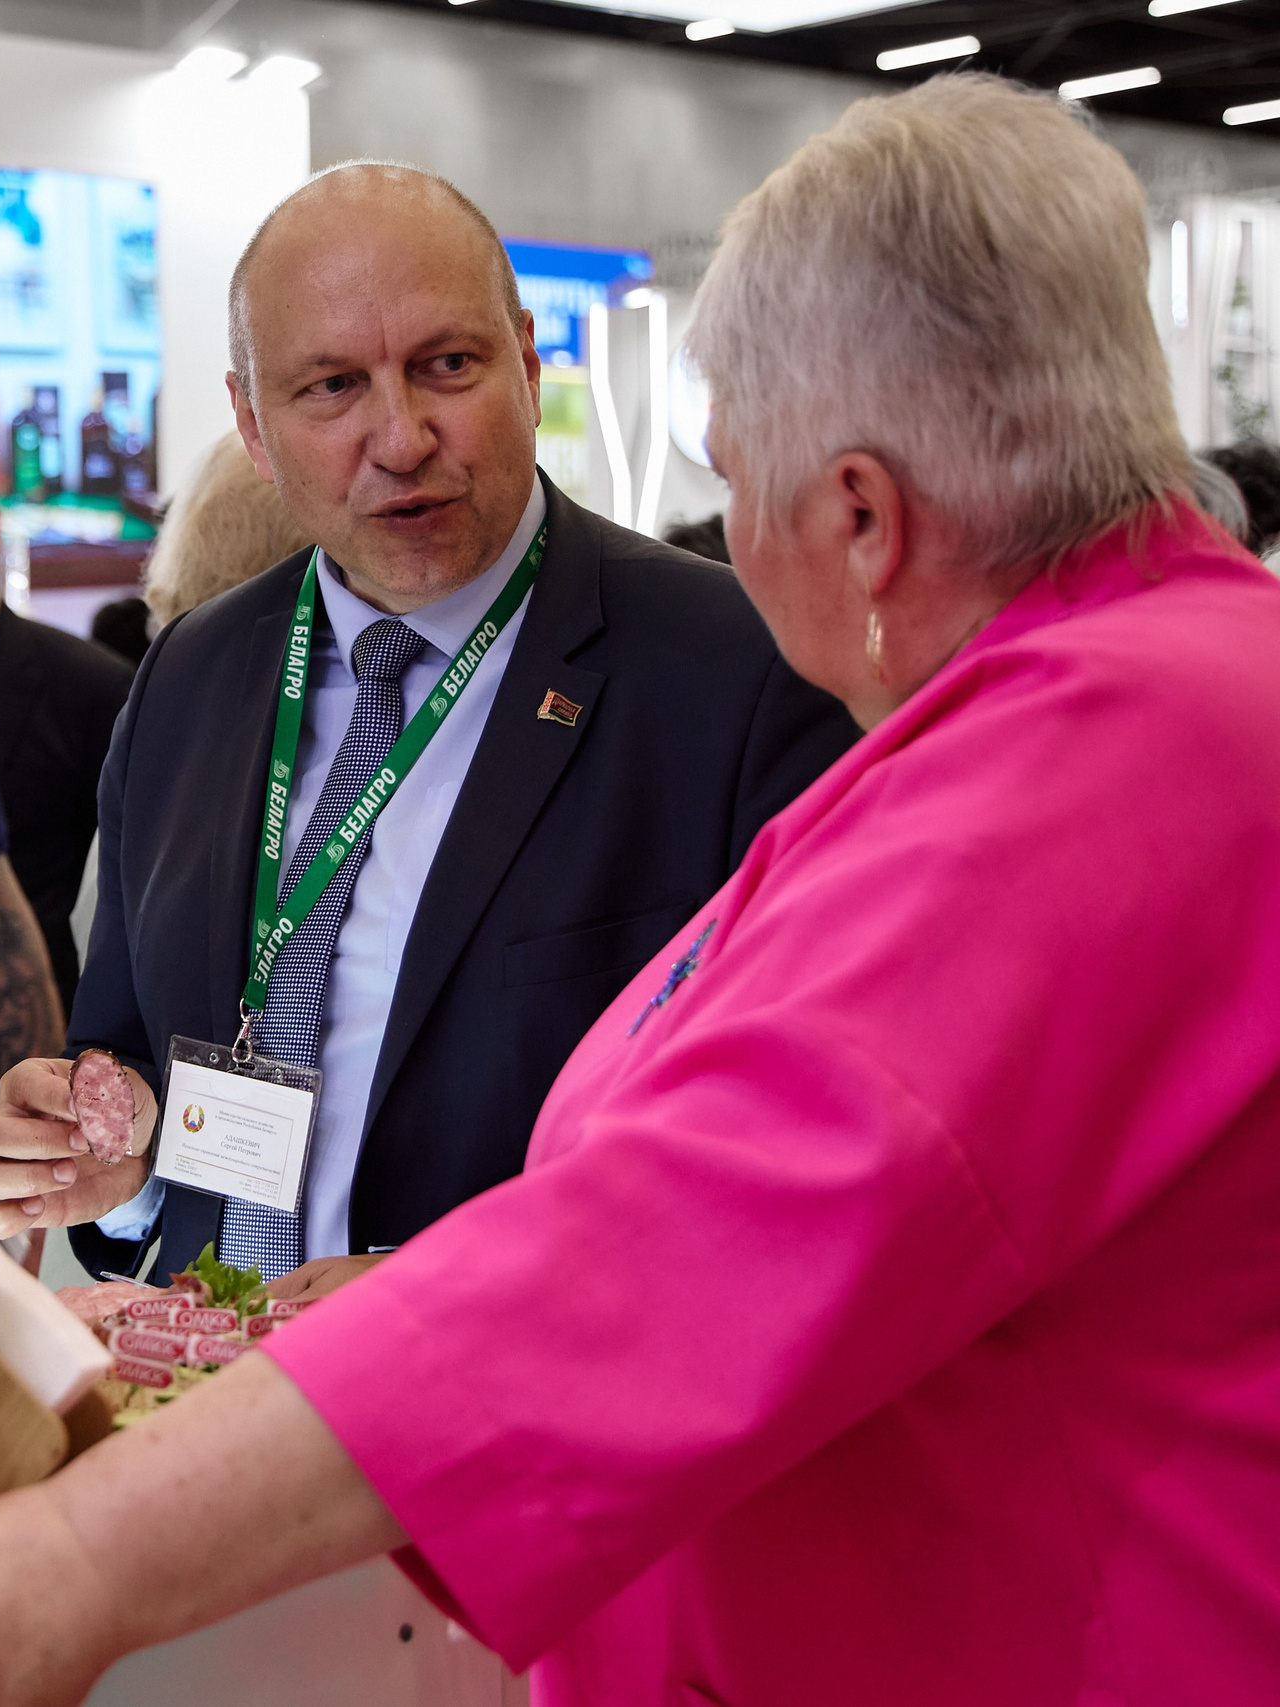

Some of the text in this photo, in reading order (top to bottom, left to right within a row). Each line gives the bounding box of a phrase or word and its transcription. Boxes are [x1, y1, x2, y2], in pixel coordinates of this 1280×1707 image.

[284, 625, 309, 699] БЕЛАГРО
[442, 621, 498, 697] БЕЛАГРО
[264, 781, 287, 860] БЕЛАГРО
[339, 767, 397, 844] БЕЛАГРО
[253, 917, 294, 985] ЕЛАГРО
[179, 1311, 233, 1328] ОМКК
